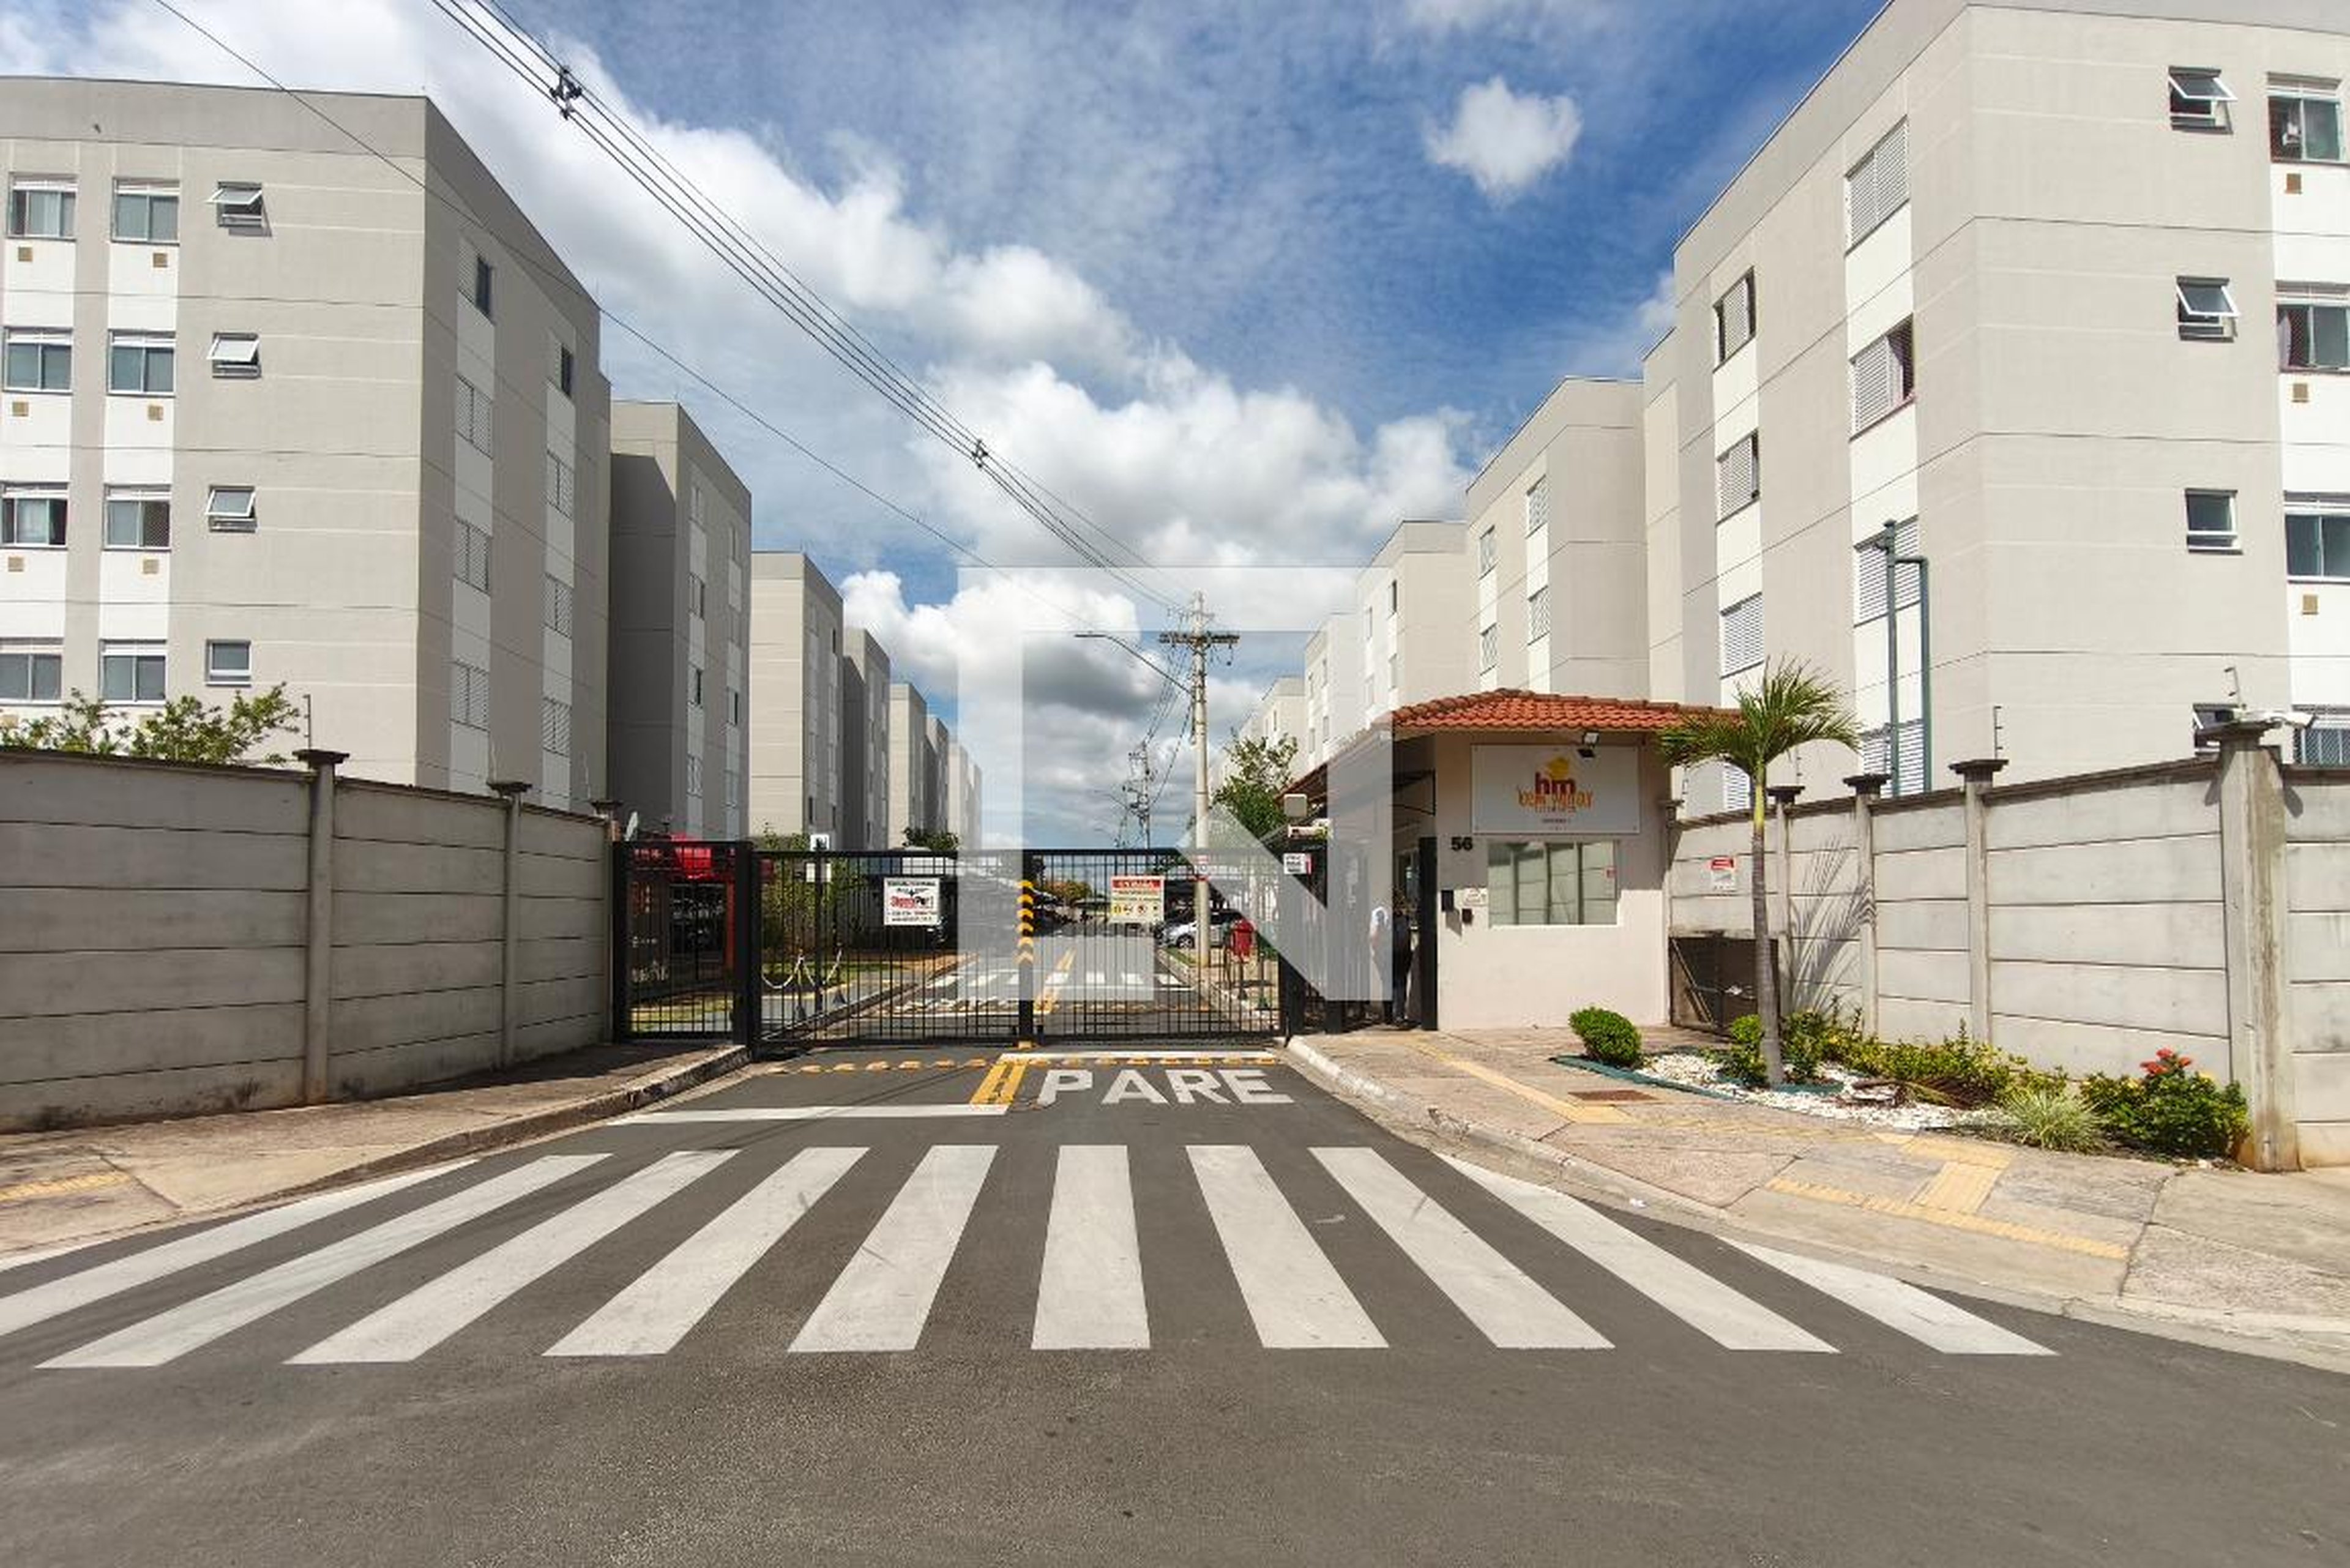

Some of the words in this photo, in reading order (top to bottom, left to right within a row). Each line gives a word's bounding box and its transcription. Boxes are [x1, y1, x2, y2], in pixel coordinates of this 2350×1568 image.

[1535, 771, 1576, 794] hm
[1451, 837, 1472, 851] 56
[1036, 1069, 1294, 1105] PARE
